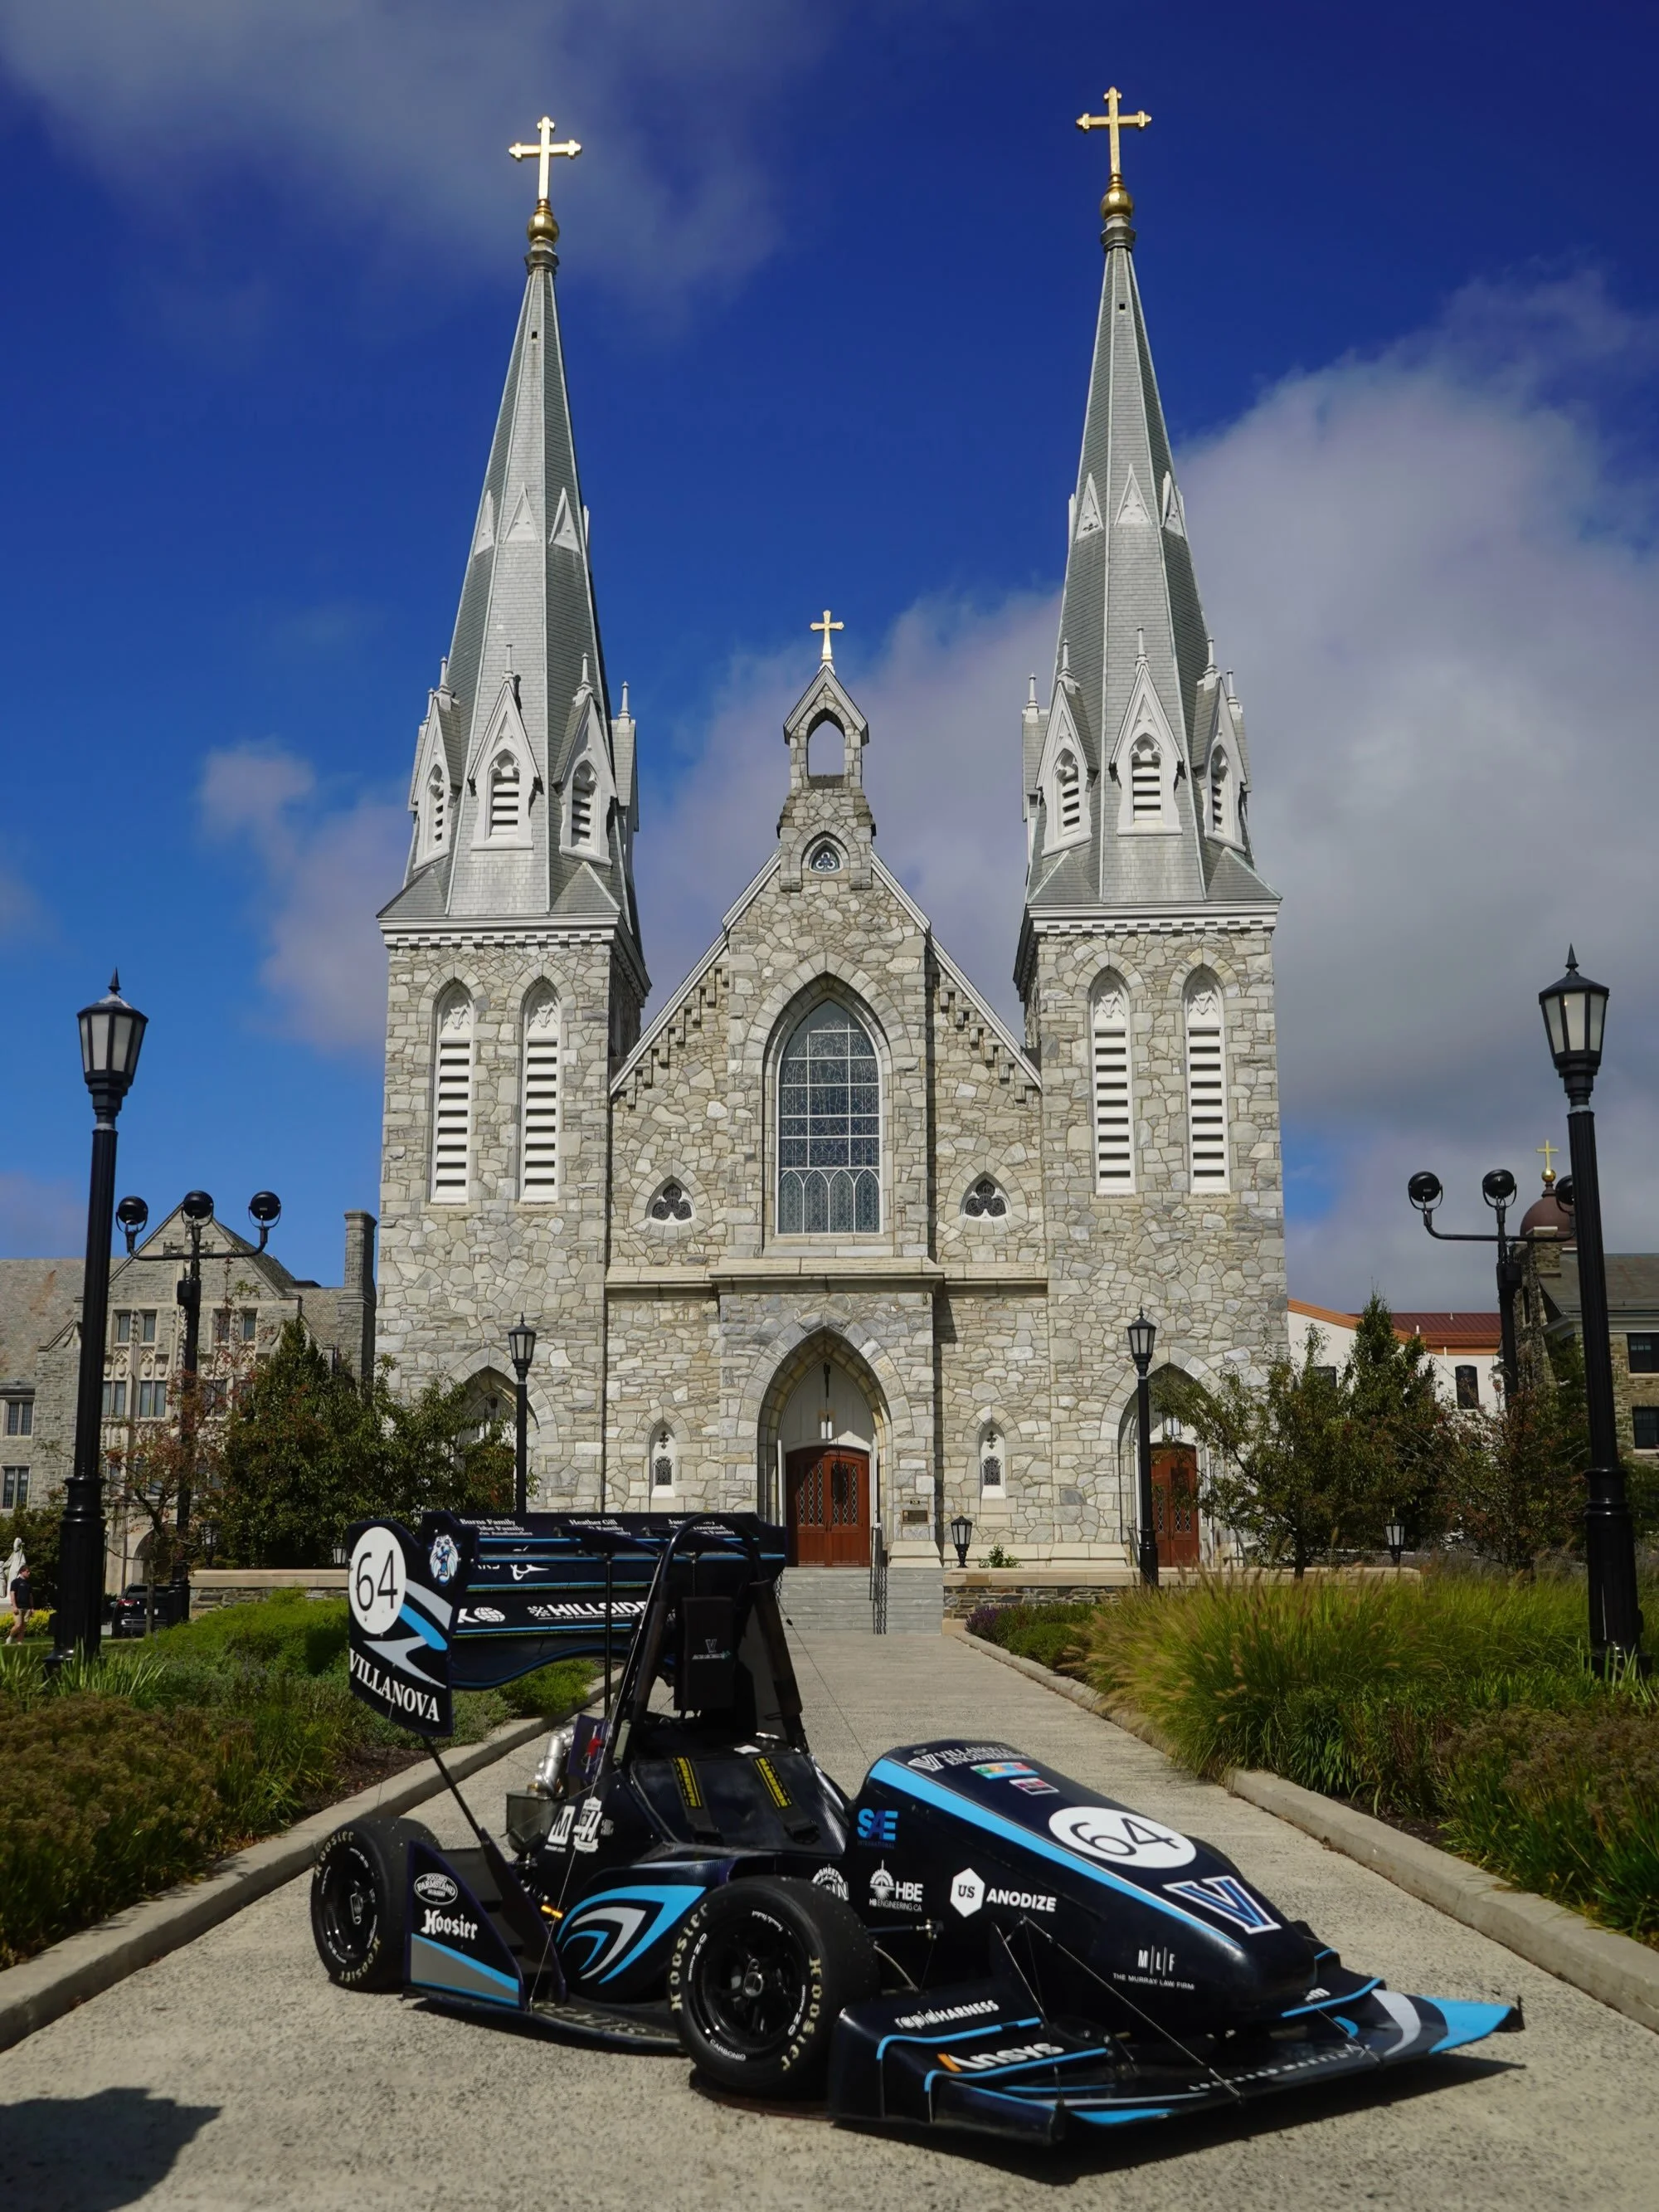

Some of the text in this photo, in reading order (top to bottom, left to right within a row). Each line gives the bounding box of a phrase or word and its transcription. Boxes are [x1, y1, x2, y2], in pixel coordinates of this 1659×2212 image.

[357, 1549, 398, 1612] 64
[349, 1648, 440, 1722] VILLANOVA
[857, 1808, 898, 1841] SAE
[1069, 1817, 1181, 1856] 64
[819, 1867, 839, 1879] SHEET
[895, 1880, 924, 1903] HBE
[958, 1884, 1057, 1912] US ANODIZE
[1162, 1875, 1282, 1935] V
[421, 1908, 479, 1940] Hoosier
[669, 1903, 708, 2011] Hoosier
[1113, 1972, 1194, 1990] THE MURRAY LAW FIRM
[781, 1956, 823, 2071] Hoosier
[894, 2000, 1000, 2030] rapidHARNESS
